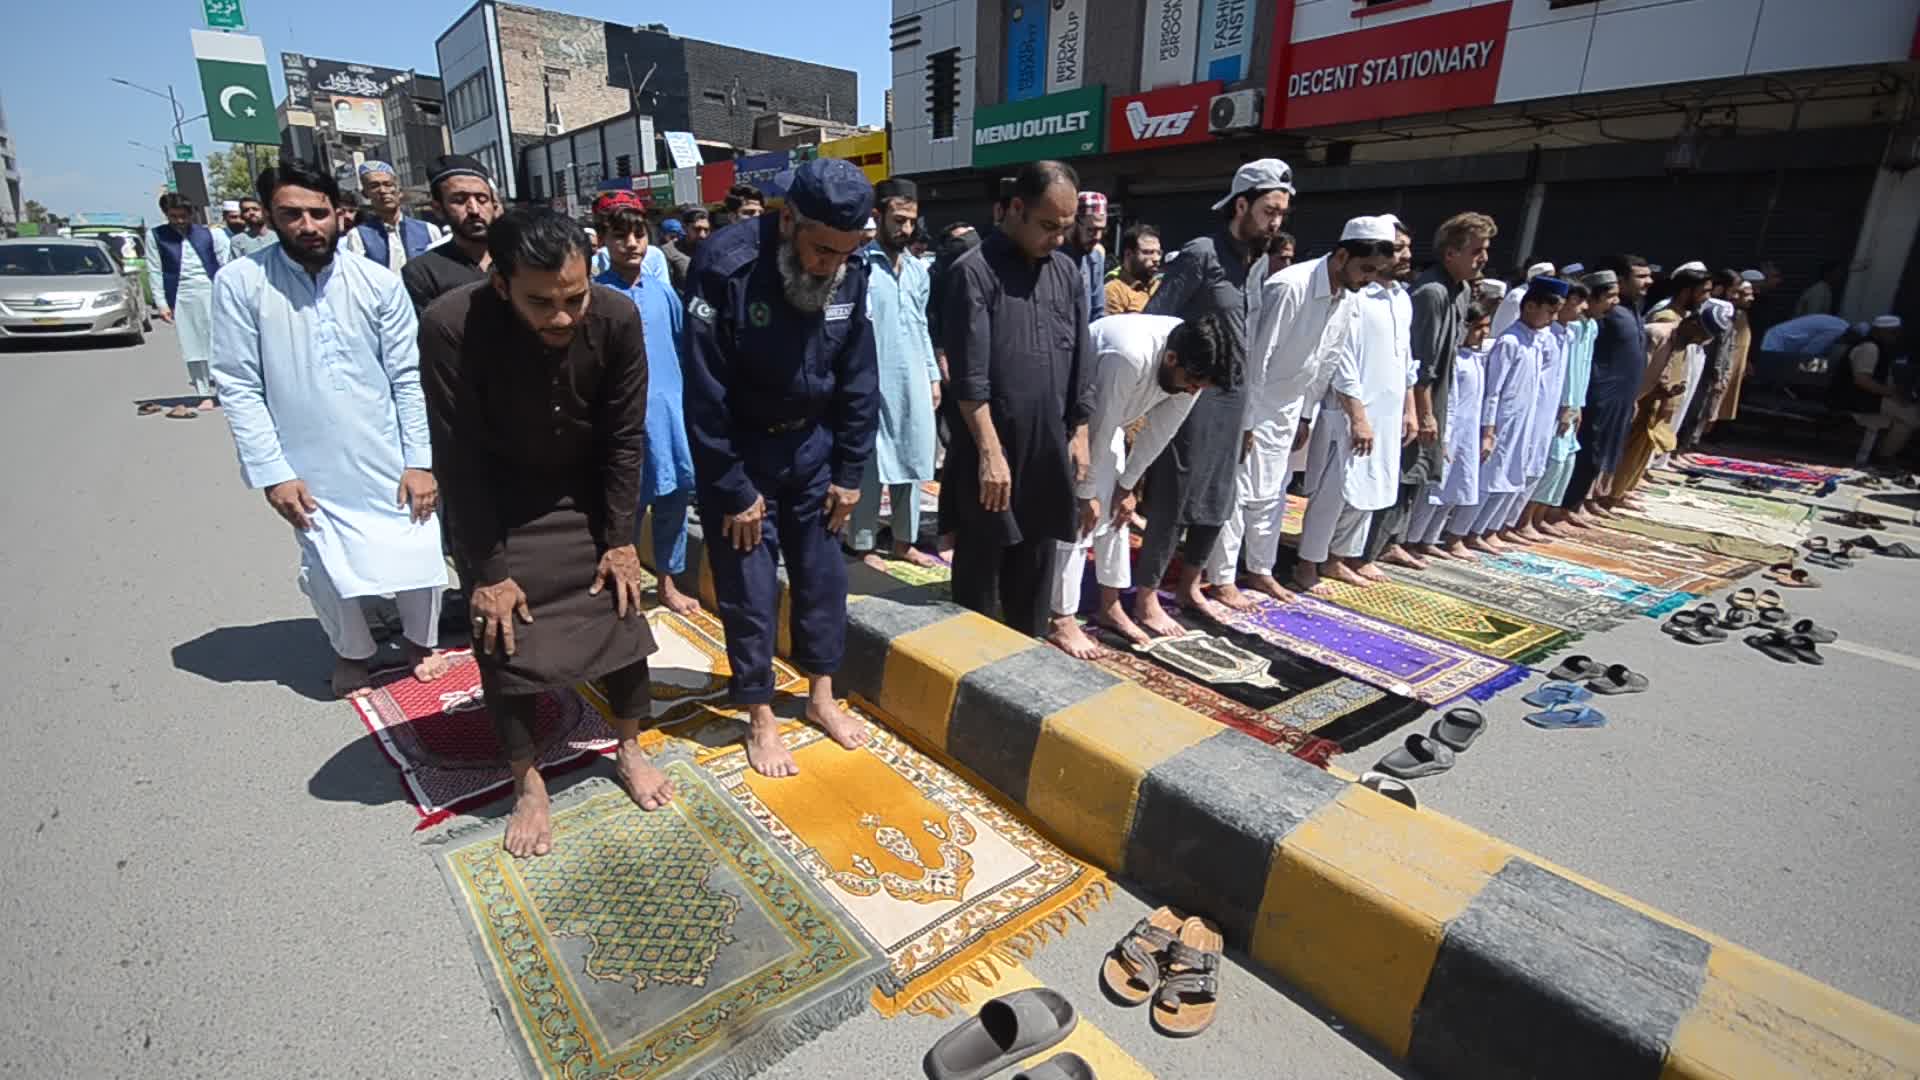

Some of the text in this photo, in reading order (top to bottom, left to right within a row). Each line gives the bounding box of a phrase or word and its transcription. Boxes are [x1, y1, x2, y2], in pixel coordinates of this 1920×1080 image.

[1065, 11, 1080, 80] MAKEUP
[1214, 0, 1229, 49] FASHI
[1056, 32, 1068, 83] BRIDAL
[1288, 40, 1495, 97] DECENT STATIONARY
[975, 110, 1091, 146] MENU OUTLET
